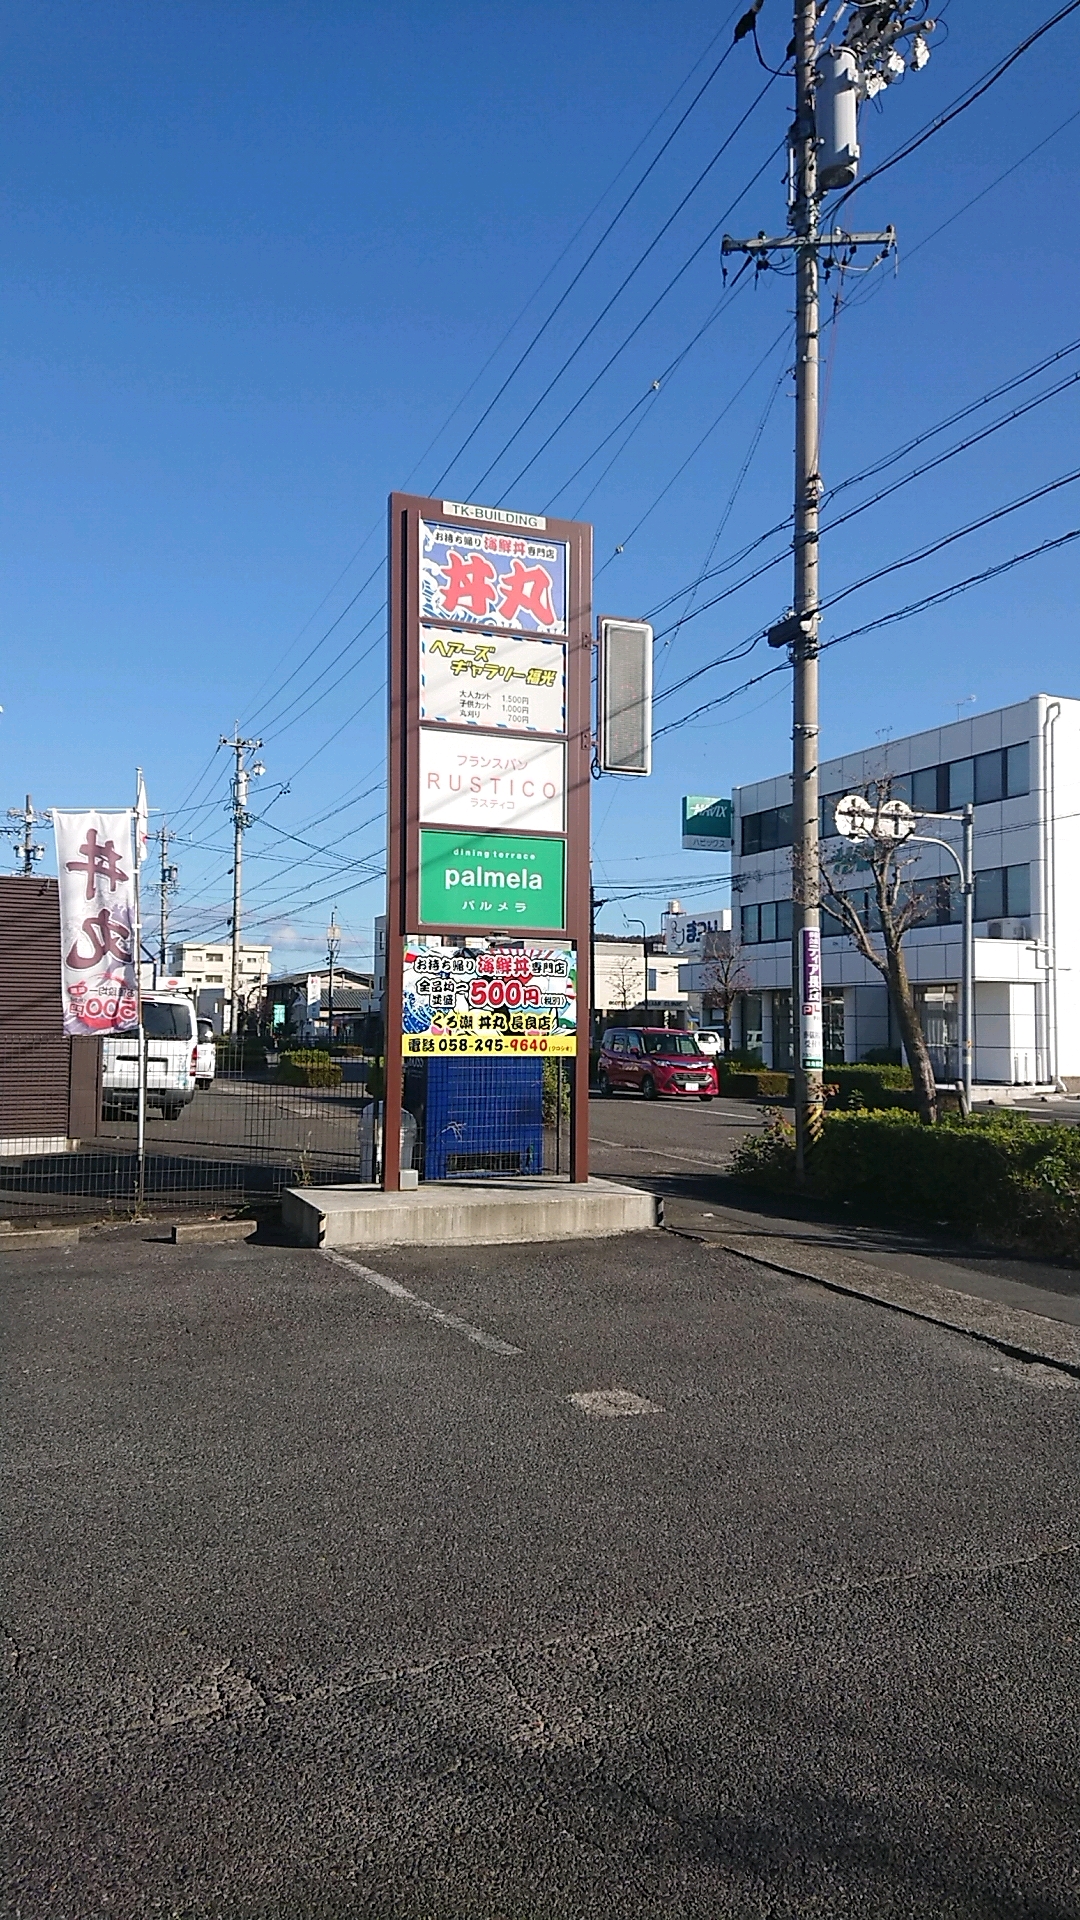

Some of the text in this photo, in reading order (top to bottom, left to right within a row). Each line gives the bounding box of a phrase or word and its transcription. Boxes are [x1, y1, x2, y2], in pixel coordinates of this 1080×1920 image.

[451, 504, 538, 527] TK-BUILDING
[439, 551, 555, 626] 丼丸
[430, 639, 495, 662] ヘアーズ
[459, 690, 491, 700] 大人カット
[459, 699, 491, 710] 子供カット
[459, 709, 529, 724] 丸刈り 700円
[427, 772, 556, 799] RUSTICO
[470, 797, 515, 810] ラスティコ
[453, 848, 489, 859] dining
[445, 866, 542, 890] palmela
[478, 1015, 506, 1030] 丼丸
[510, 1015, 551, 1030] 長良店
[408, 1037, 435, 1052] 電話
[438, 1038, 548, 1052] 058-295-9640
